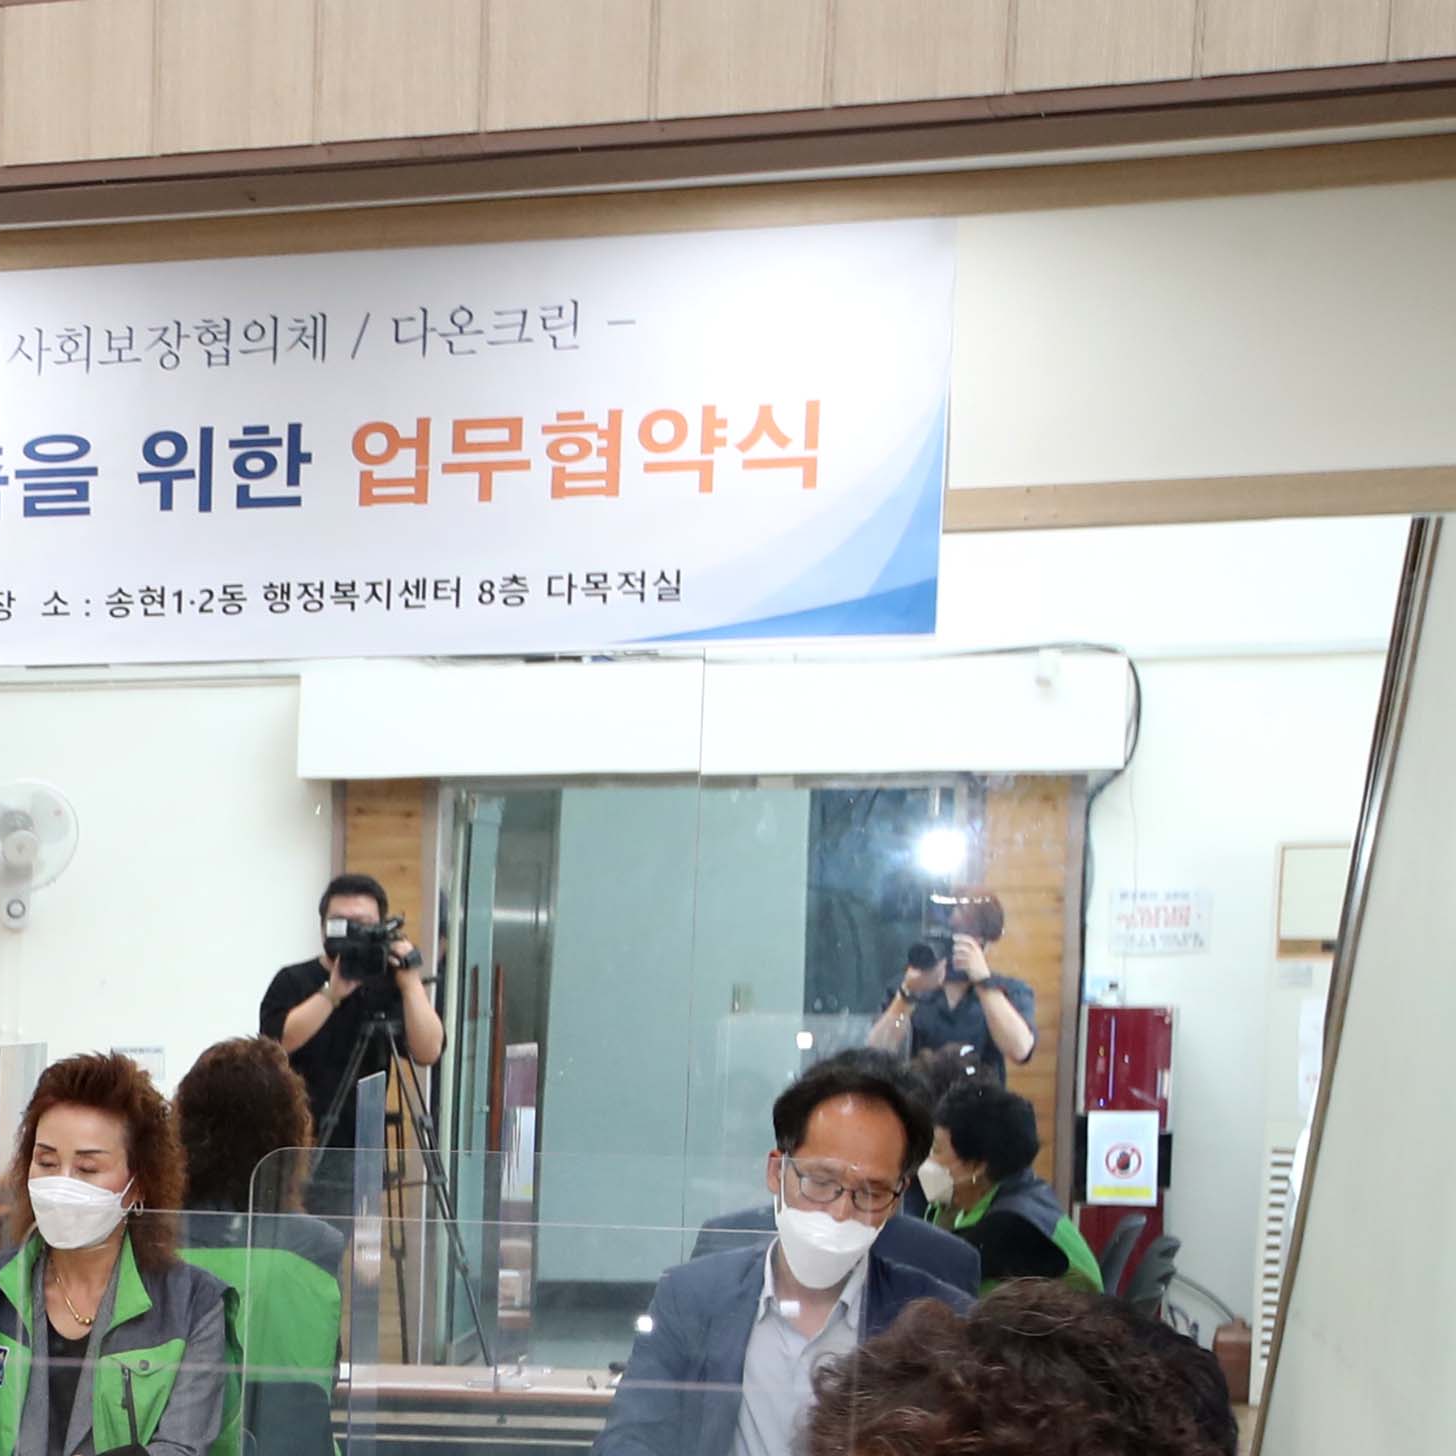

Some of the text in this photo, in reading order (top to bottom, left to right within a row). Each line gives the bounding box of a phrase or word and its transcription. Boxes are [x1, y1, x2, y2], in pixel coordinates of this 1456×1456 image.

[391, 298, 581, 358] 다온크린
[136, 423, 313, 513] 위한
[350, 400, 824, 508] 업무협약식
[105, 583, 249, 620] 송현1·2동
[262, 575, 463, 616] 행정복지센터
[477, 573, 532, 608] 8층
[546, 568, 684, 606] 다목적실
